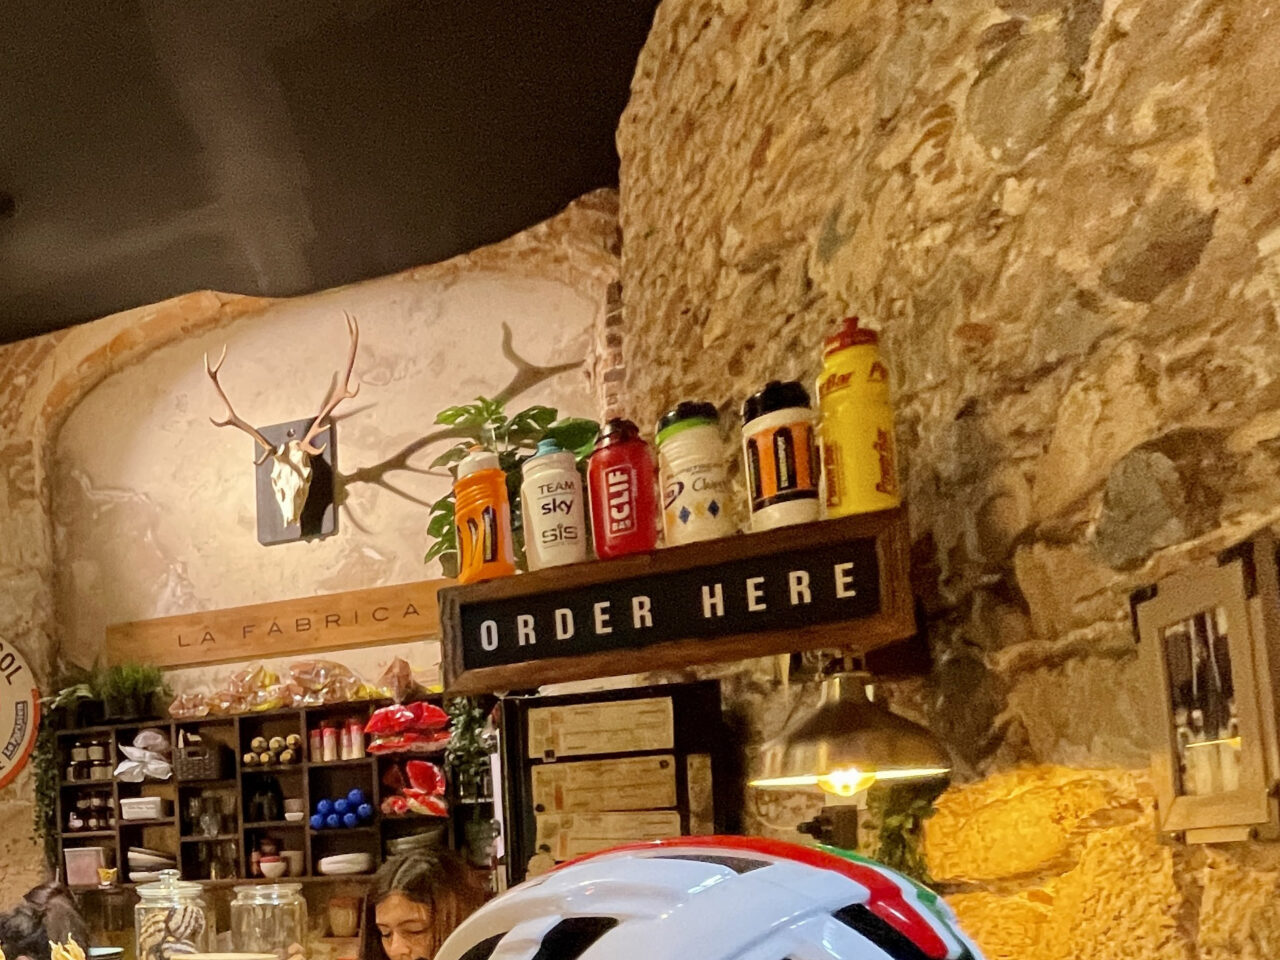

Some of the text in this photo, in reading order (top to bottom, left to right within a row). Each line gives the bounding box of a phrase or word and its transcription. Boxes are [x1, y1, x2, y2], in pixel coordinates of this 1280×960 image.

[537, 481, 576, 495] TEAM
[608, 470, 631, 520] CLIF
[541, 498, 573, 515] sky
[480, 562, 857, 651] ORDER HERE
[177, 631, 216, 648] LA
